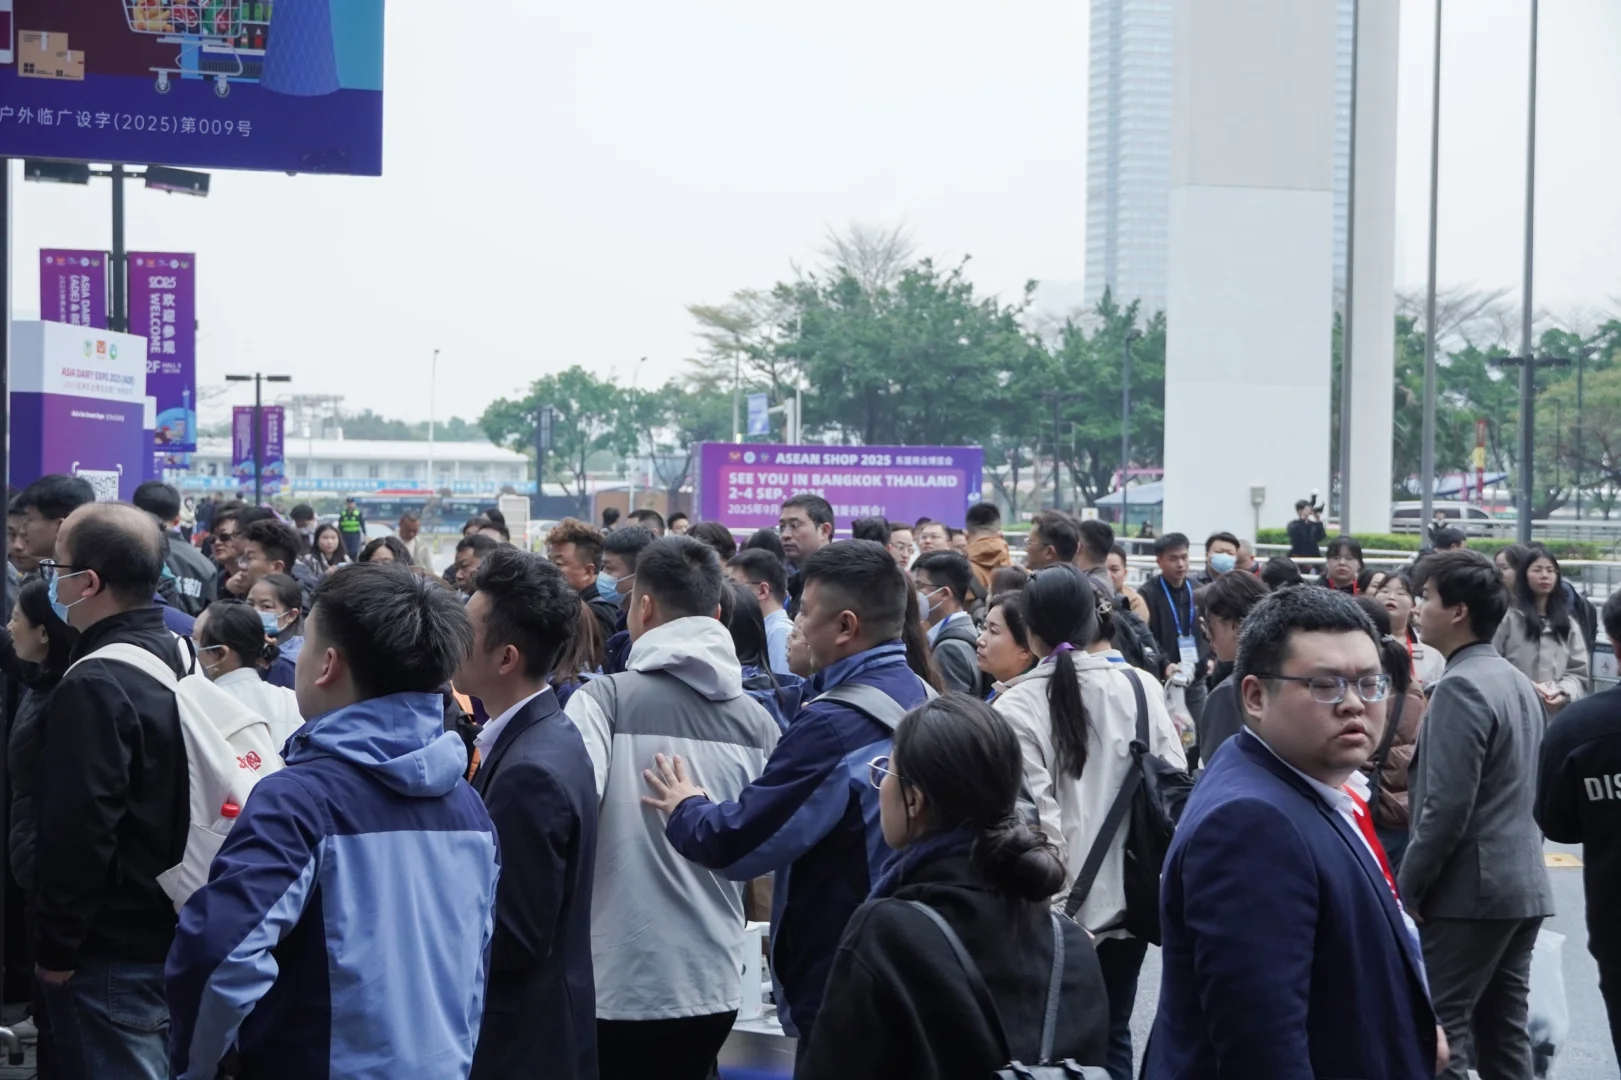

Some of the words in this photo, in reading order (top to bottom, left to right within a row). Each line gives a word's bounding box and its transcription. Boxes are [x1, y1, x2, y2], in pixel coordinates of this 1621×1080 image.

[81, 273, 91, 298] ASIA
[148, 276, 177, 289] 2025
[149, 293, 161, 354] WELCOME
[146, 360, 161, 374] 2F
[61, 367, 76, 377] ASIA
[76, 369, 94, 379] DAIRY
[95, 372, 110, 382] EXPO
[775, 452, 820, 465] ASEAN
[822, 453, 859, 465] SHOP
[861, 454, 892, 466] 2025
[728, 472, 755, 485] SEE
[757, 473, 789, 485] YOU
[791, 473, 809, 486] IN
[811, 474, 882, 487] BANGKOK
[885, 475, 958, 487] THAILAND
[728, 487, 753, 499] 2-4
[756, 488, 787, 500] SEP.
